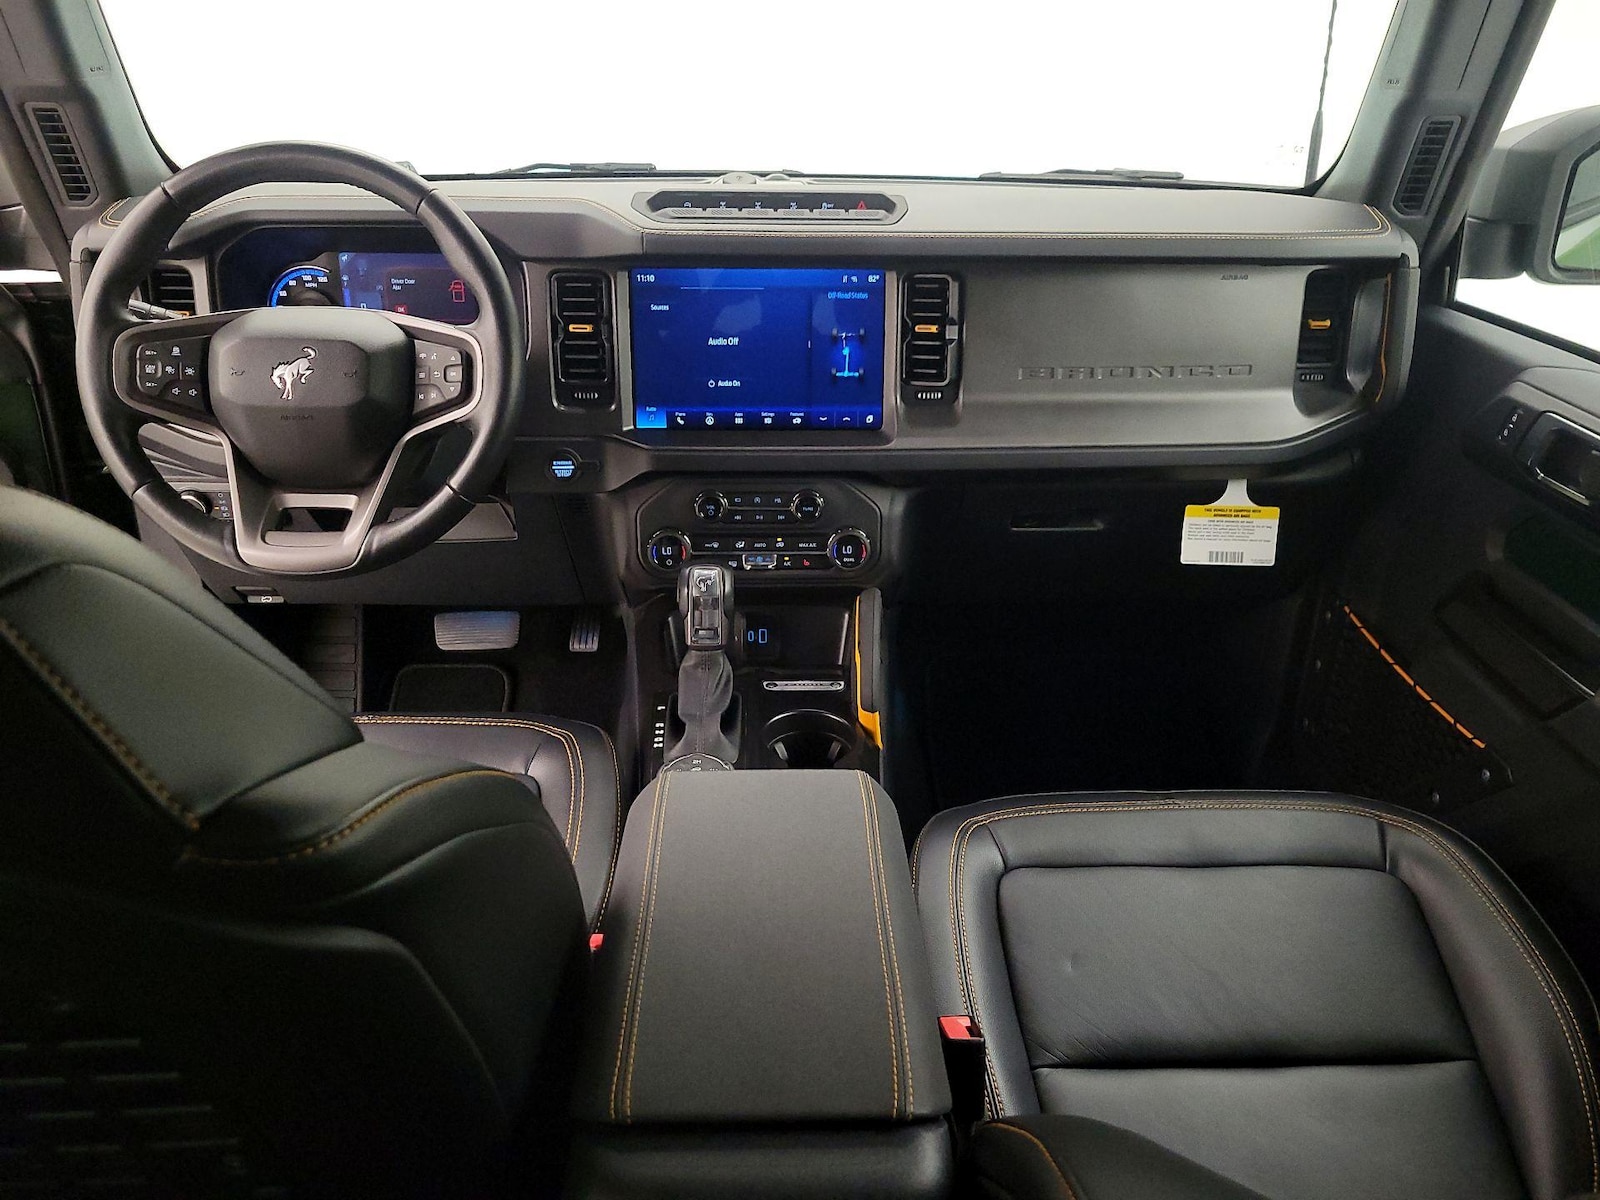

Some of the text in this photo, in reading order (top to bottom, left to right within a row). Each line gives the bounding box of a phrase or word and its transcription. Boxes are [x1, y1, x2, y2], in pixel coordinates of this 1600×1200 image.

[636, 274, 655, 282] 11:10
[708, 337, 740, 346] Audio Off
[1018, 364, 1253, 380] BRONCO
[661, 546, 672, 555] LO
[842, 545, 852, 554] LO
